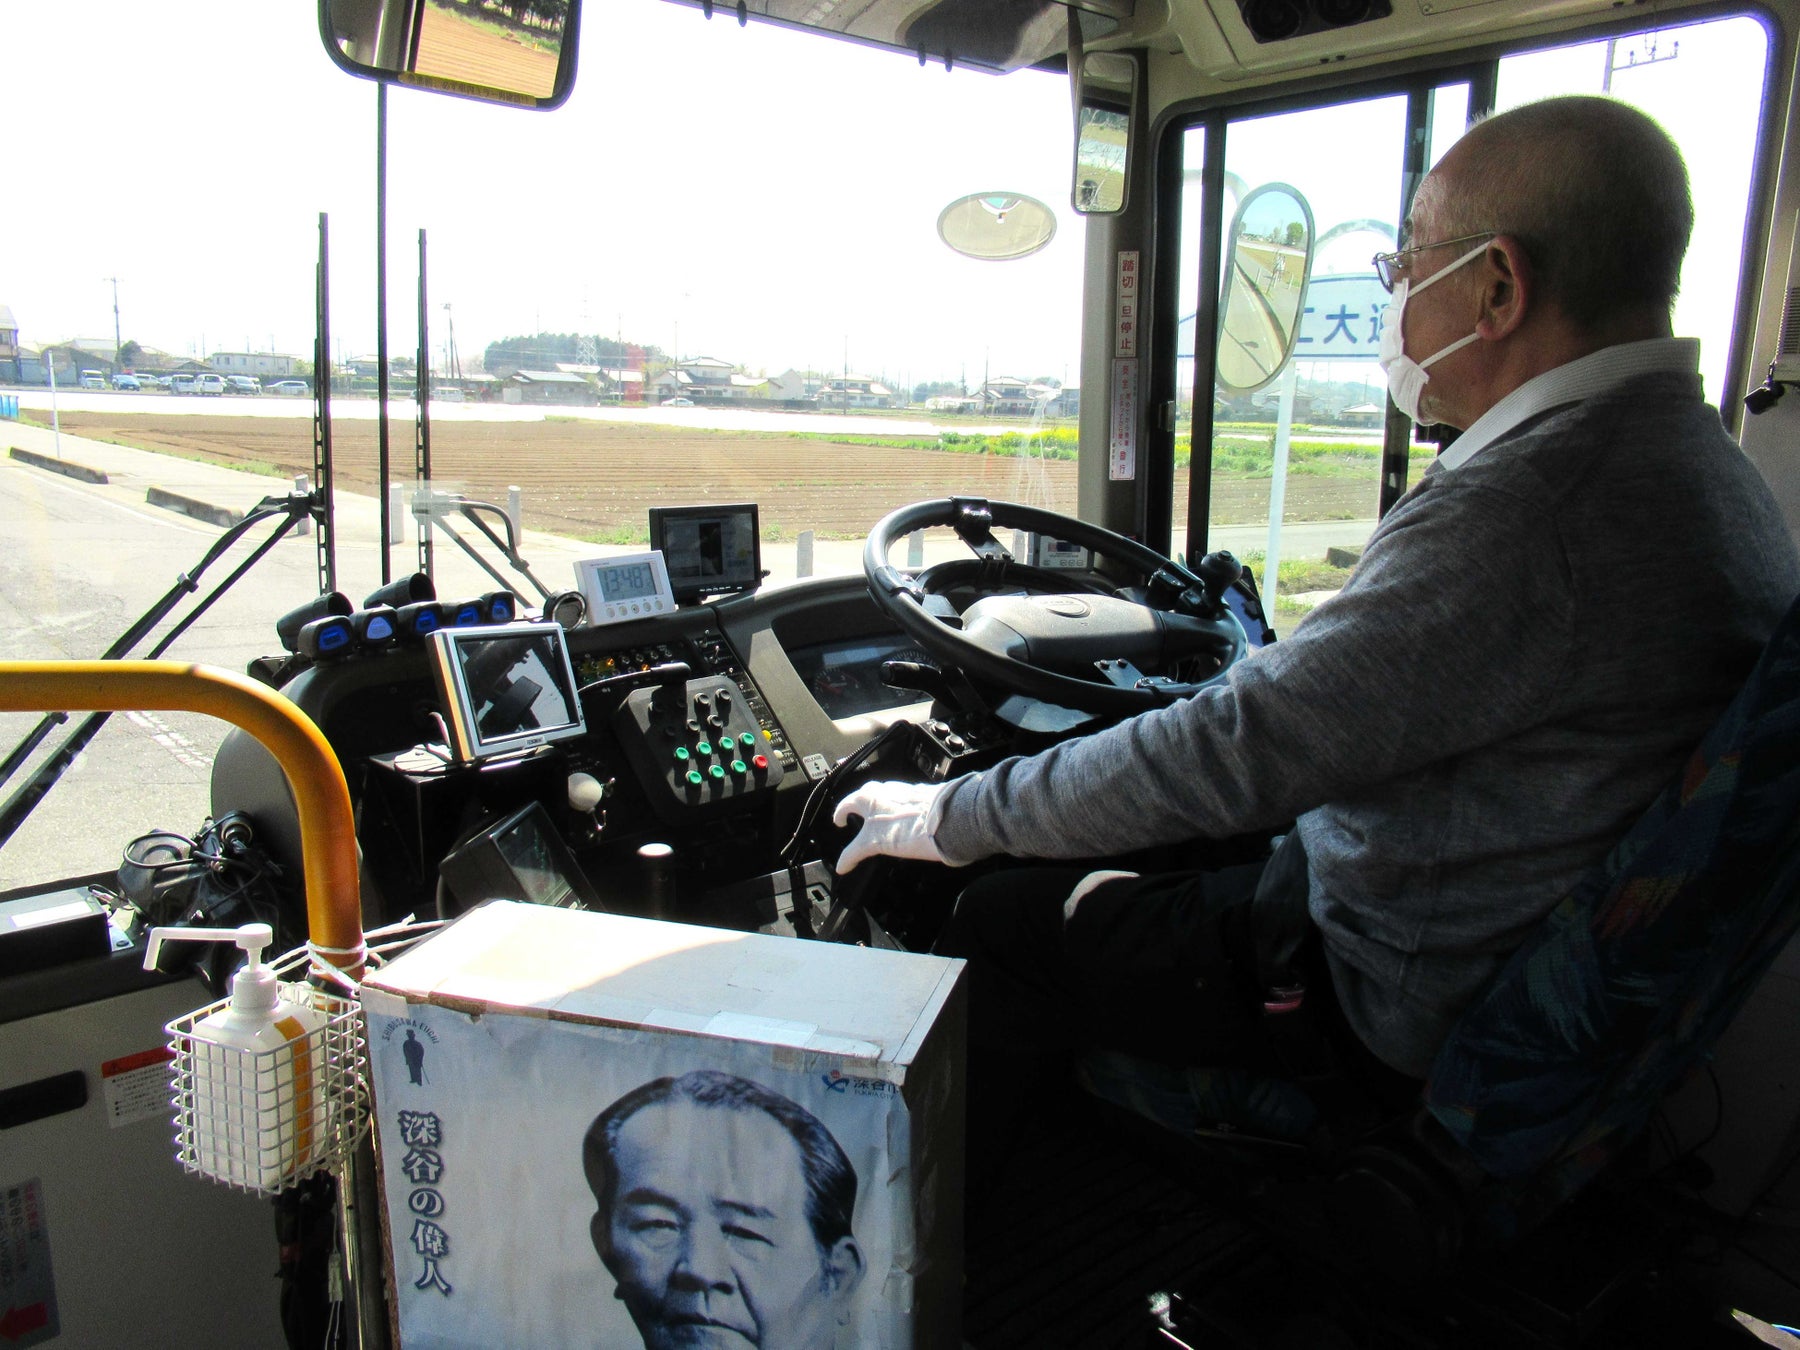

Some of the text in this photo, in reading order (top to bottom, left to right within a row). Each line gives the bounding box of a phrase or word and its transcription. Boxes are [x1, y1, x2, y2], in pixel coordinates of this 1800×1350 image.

[1120, 259, 1135, 350] 踏切一旦停止
[603, 566, 644, 592] 13:48
[398, 1110, 451, 1297] 深谷の偉人
